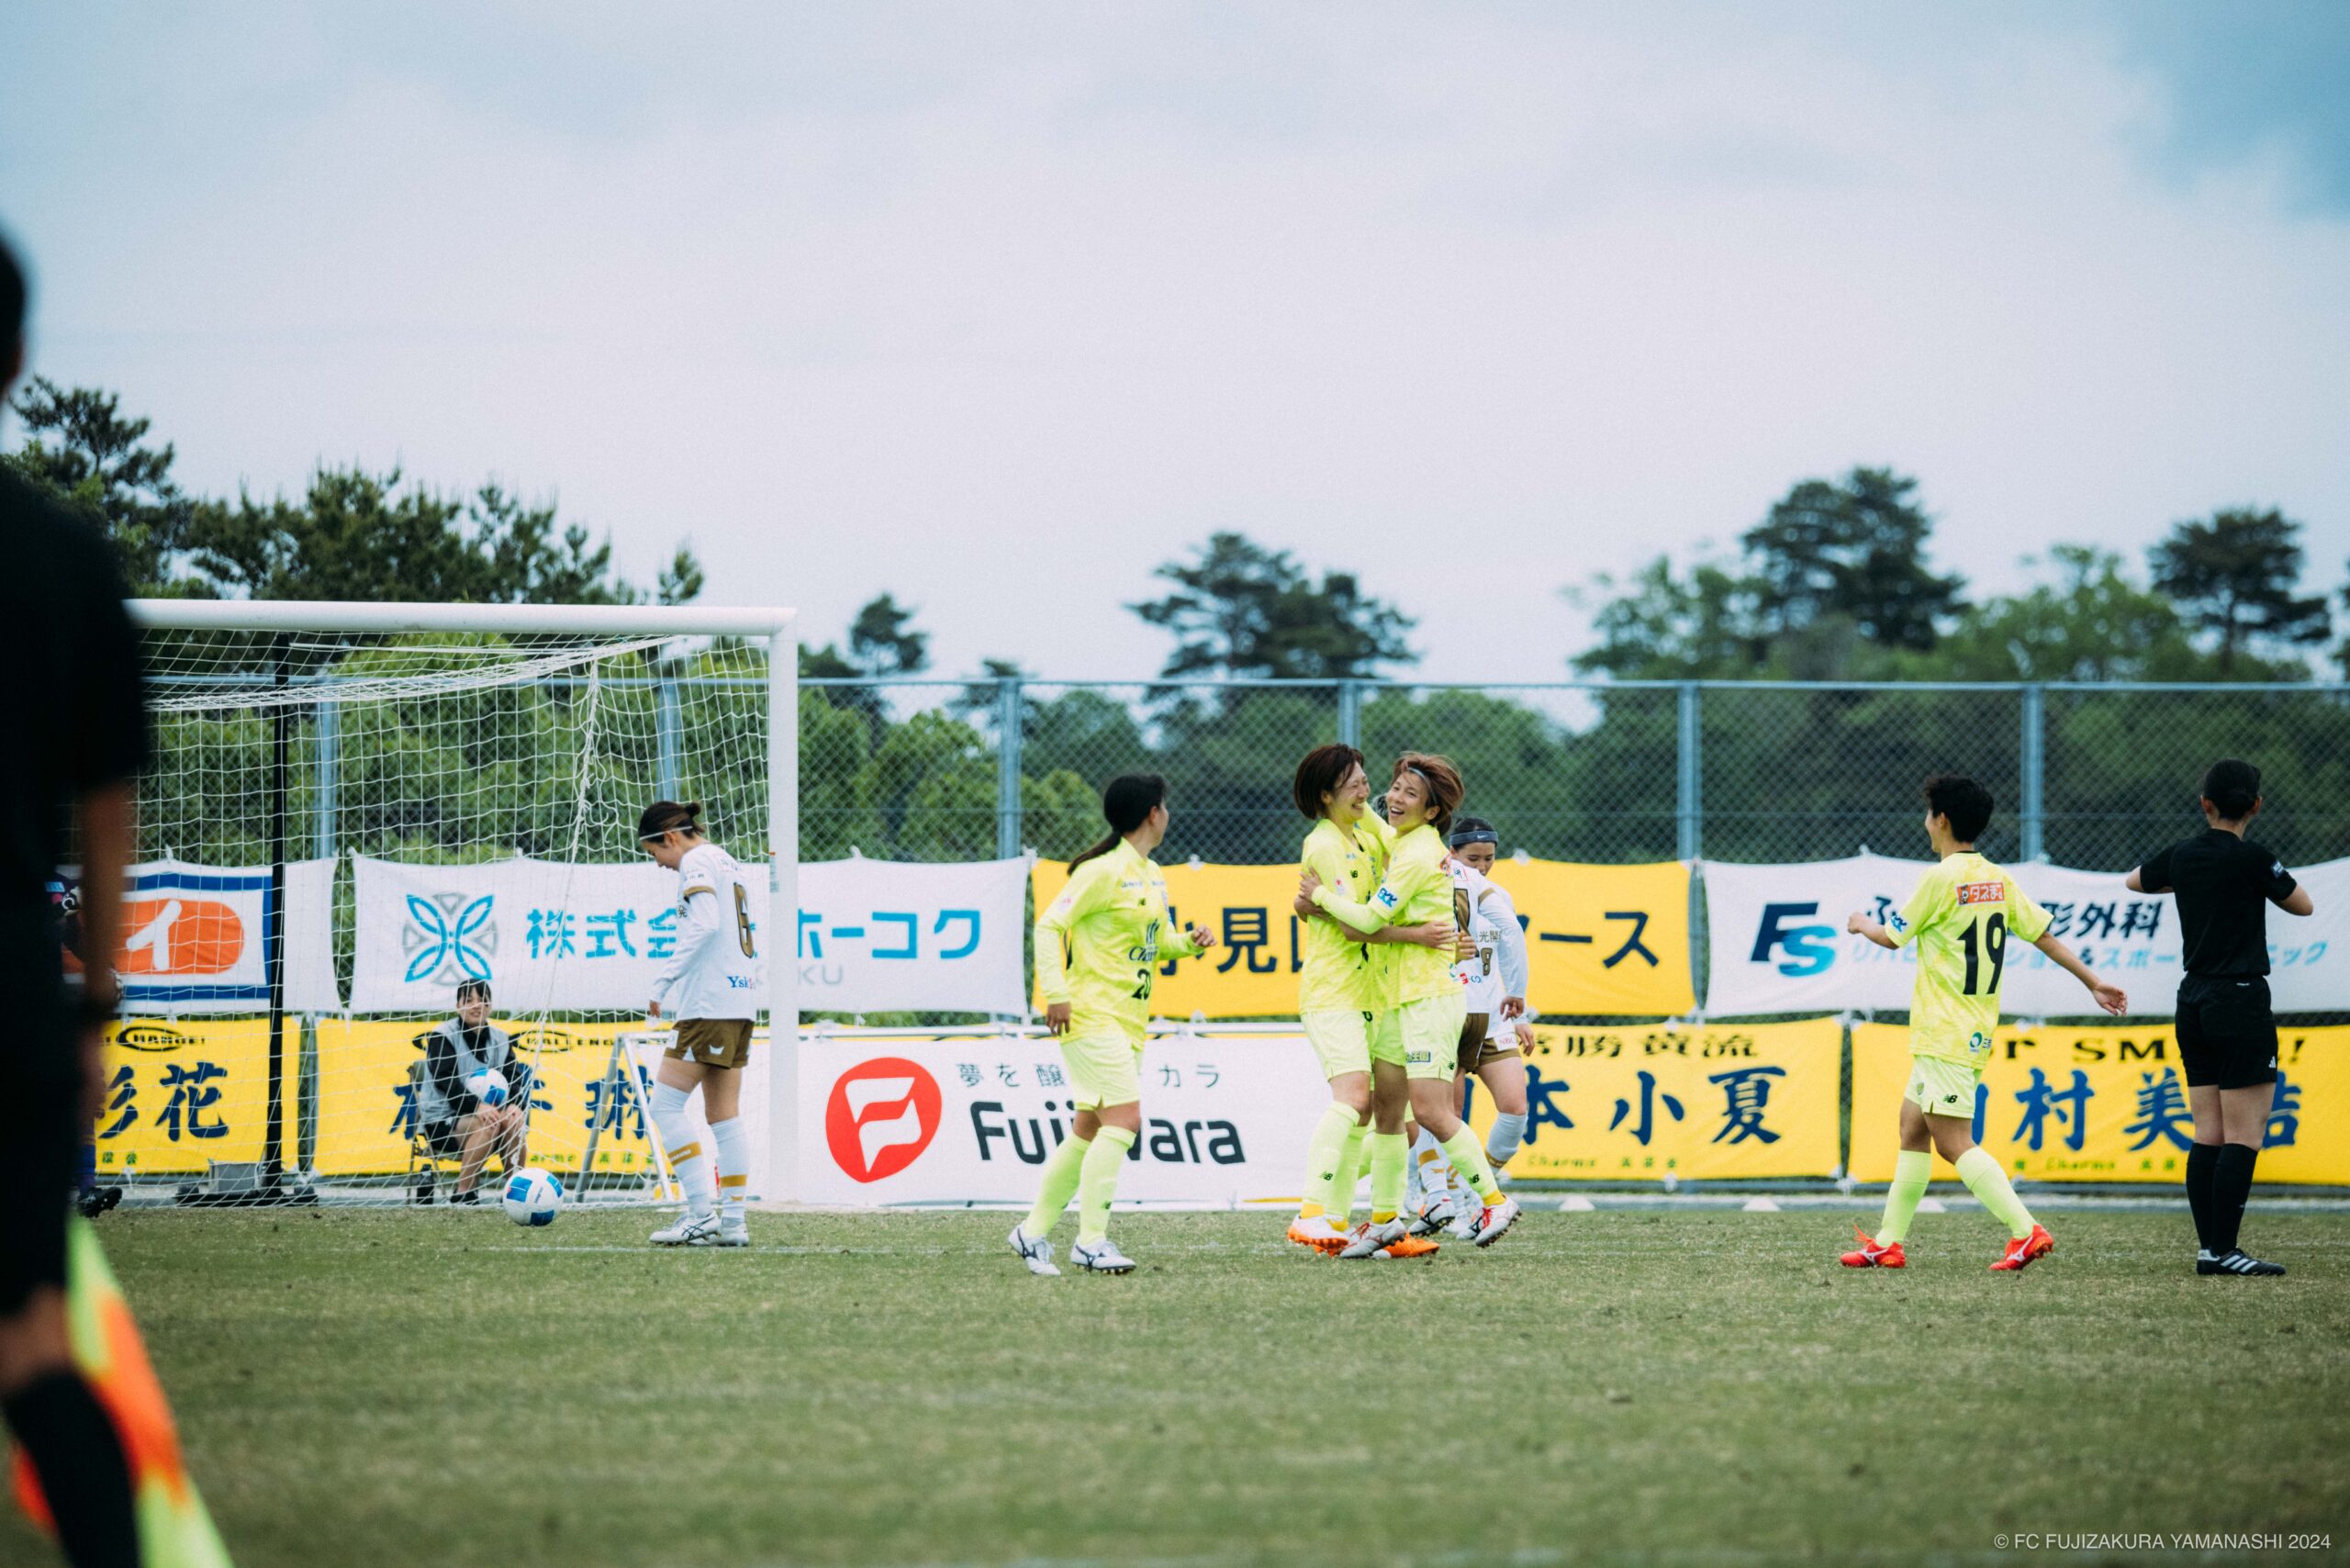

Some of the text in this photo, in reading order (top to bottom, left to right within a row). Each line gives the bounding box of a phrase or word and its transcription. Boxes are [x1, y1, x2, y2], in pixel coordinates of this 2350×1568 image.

[126, 899, 183, 971] イ
[525, 908, 981, 959] 株式会ホーコク
[733, 881, 763, 958] 6
[1515, 911, 1660, 969] ース
[1750, 902, 1838, 978] FS
[1956, 913, 2007, 995] 19
[2007, 901, 2165, 939] 形外科
[969, 1100, 1247, 1165] Fujara
[1461, 1063, 1787, 1147] 本小夏
